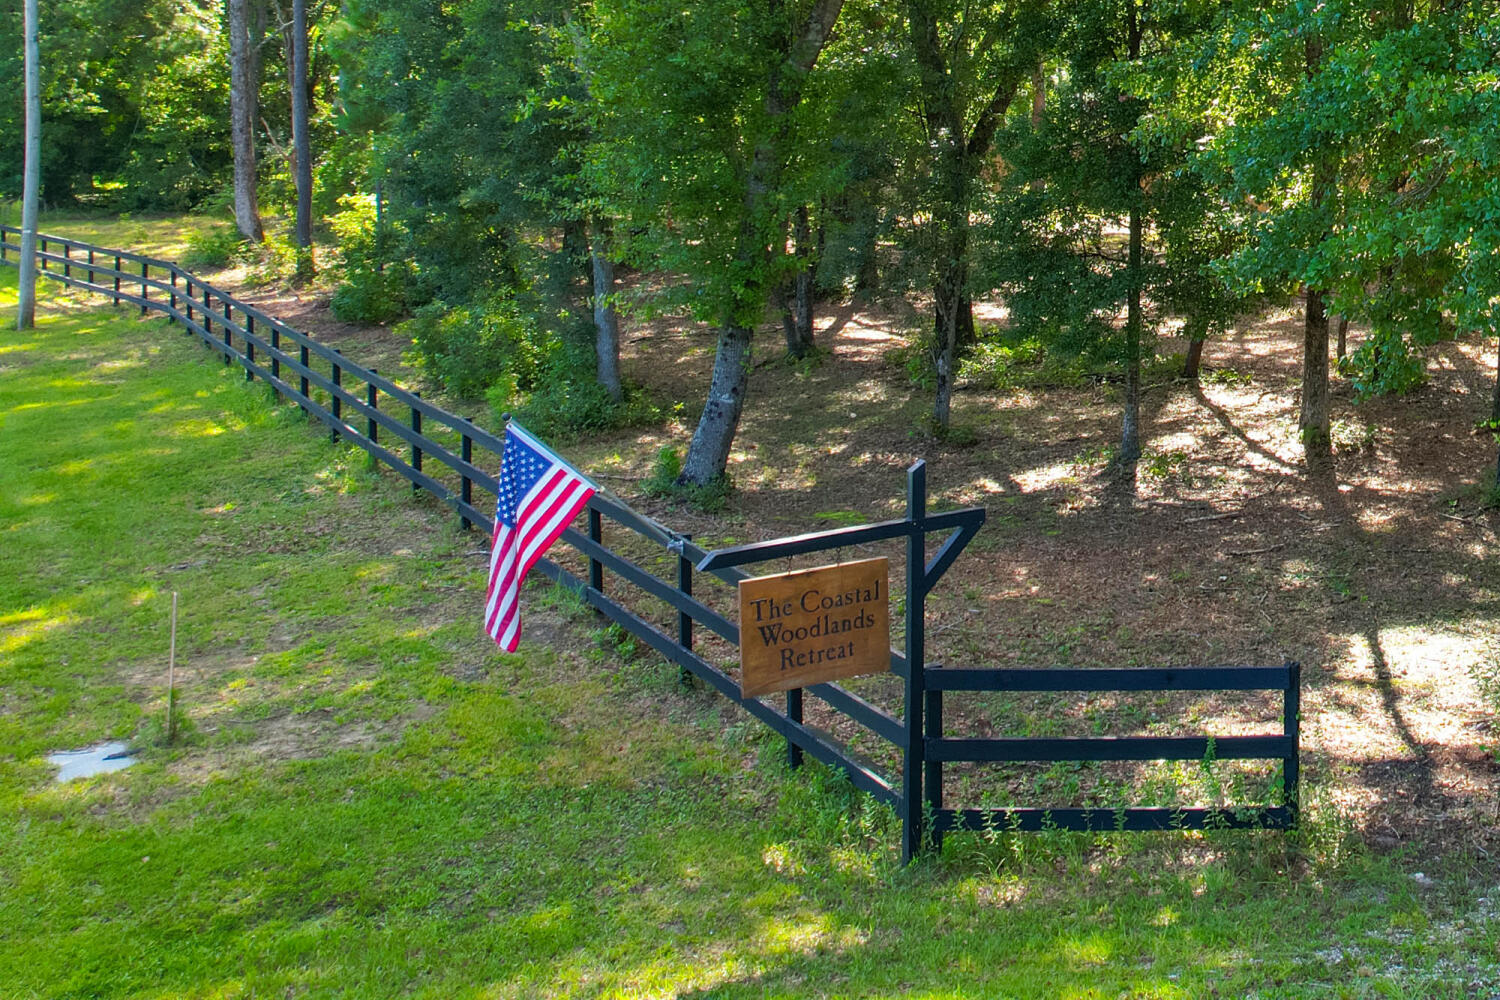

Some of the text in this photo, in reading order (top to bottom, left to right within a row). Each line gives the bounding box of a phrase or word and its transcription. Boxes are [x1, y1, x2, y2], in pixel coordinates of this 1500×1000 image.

[750, 579, 880, 622] The Coastal
[758, 608, 875, 647] Woodlands
[780, 641, 855, 671] Retreat
